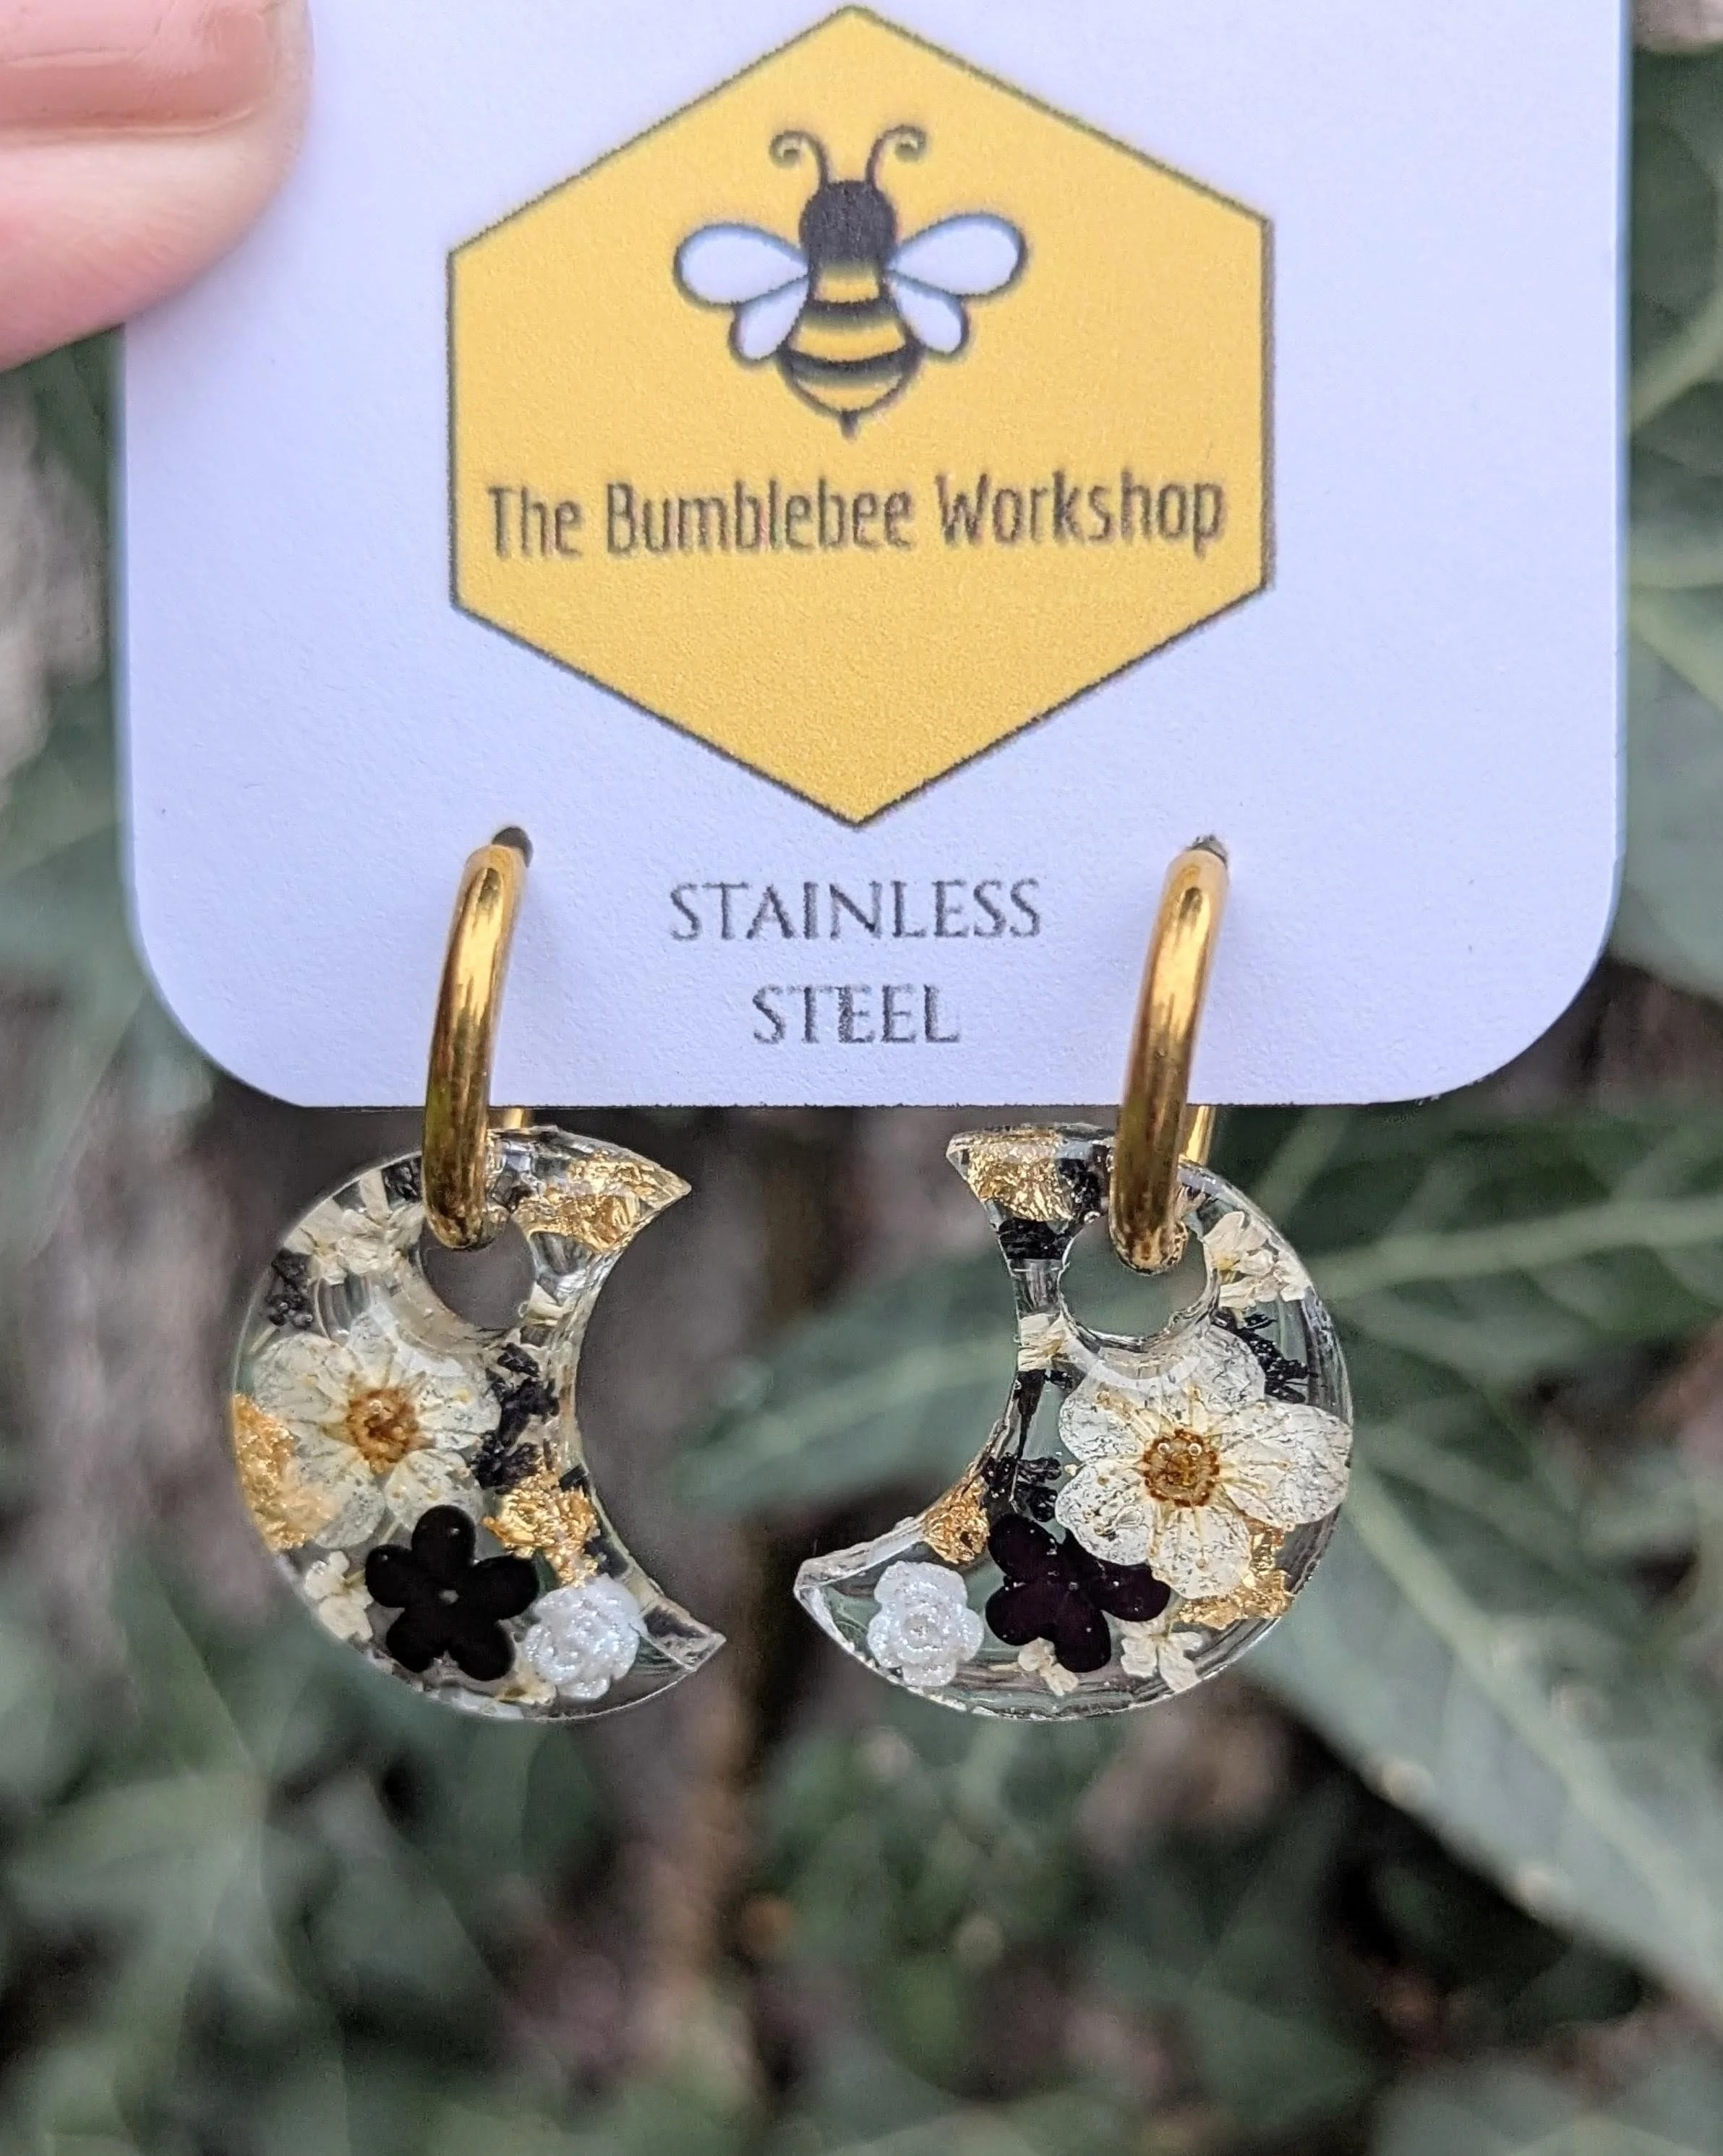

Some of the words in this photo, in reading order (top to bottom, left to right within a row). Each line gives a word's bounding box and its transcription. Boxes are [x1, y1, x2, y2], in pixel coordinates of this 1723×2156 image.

[488, 485, 581, 559] The
[604, 478, 916, 558] Bumblebee
[936, 468, 1226, 558] Workshop
[670, 878, 1041, 940] STAINLESS
[752, 984, 961, 1044] STEEL
